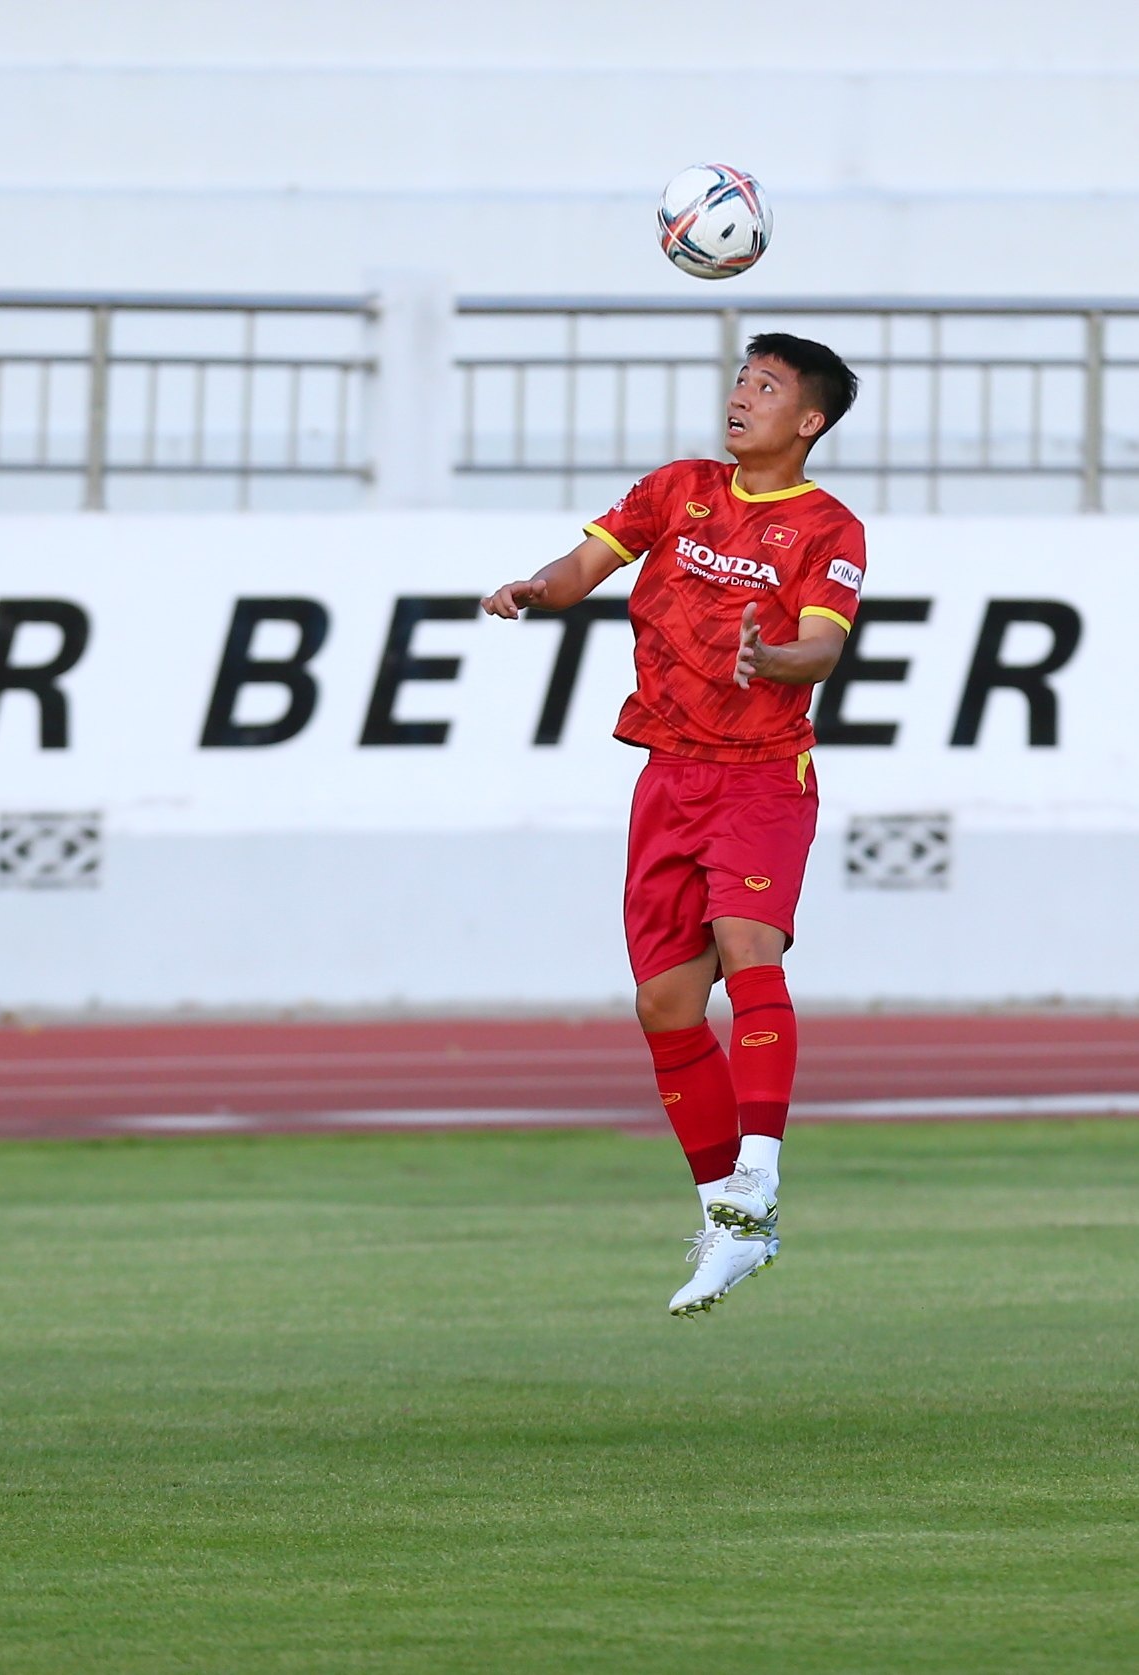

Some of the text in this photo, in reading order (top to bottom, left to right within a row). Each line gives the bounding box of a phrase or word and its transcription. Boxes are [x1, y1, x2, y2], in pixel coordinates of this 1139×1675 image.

[675, 536, 781, 587] HONDA
[686, 563, 719, 584] Power
[719, 575, 731, 584] of
[730, 577, 770, 590] Dream
[198, 596, 1084, 750] BETER
